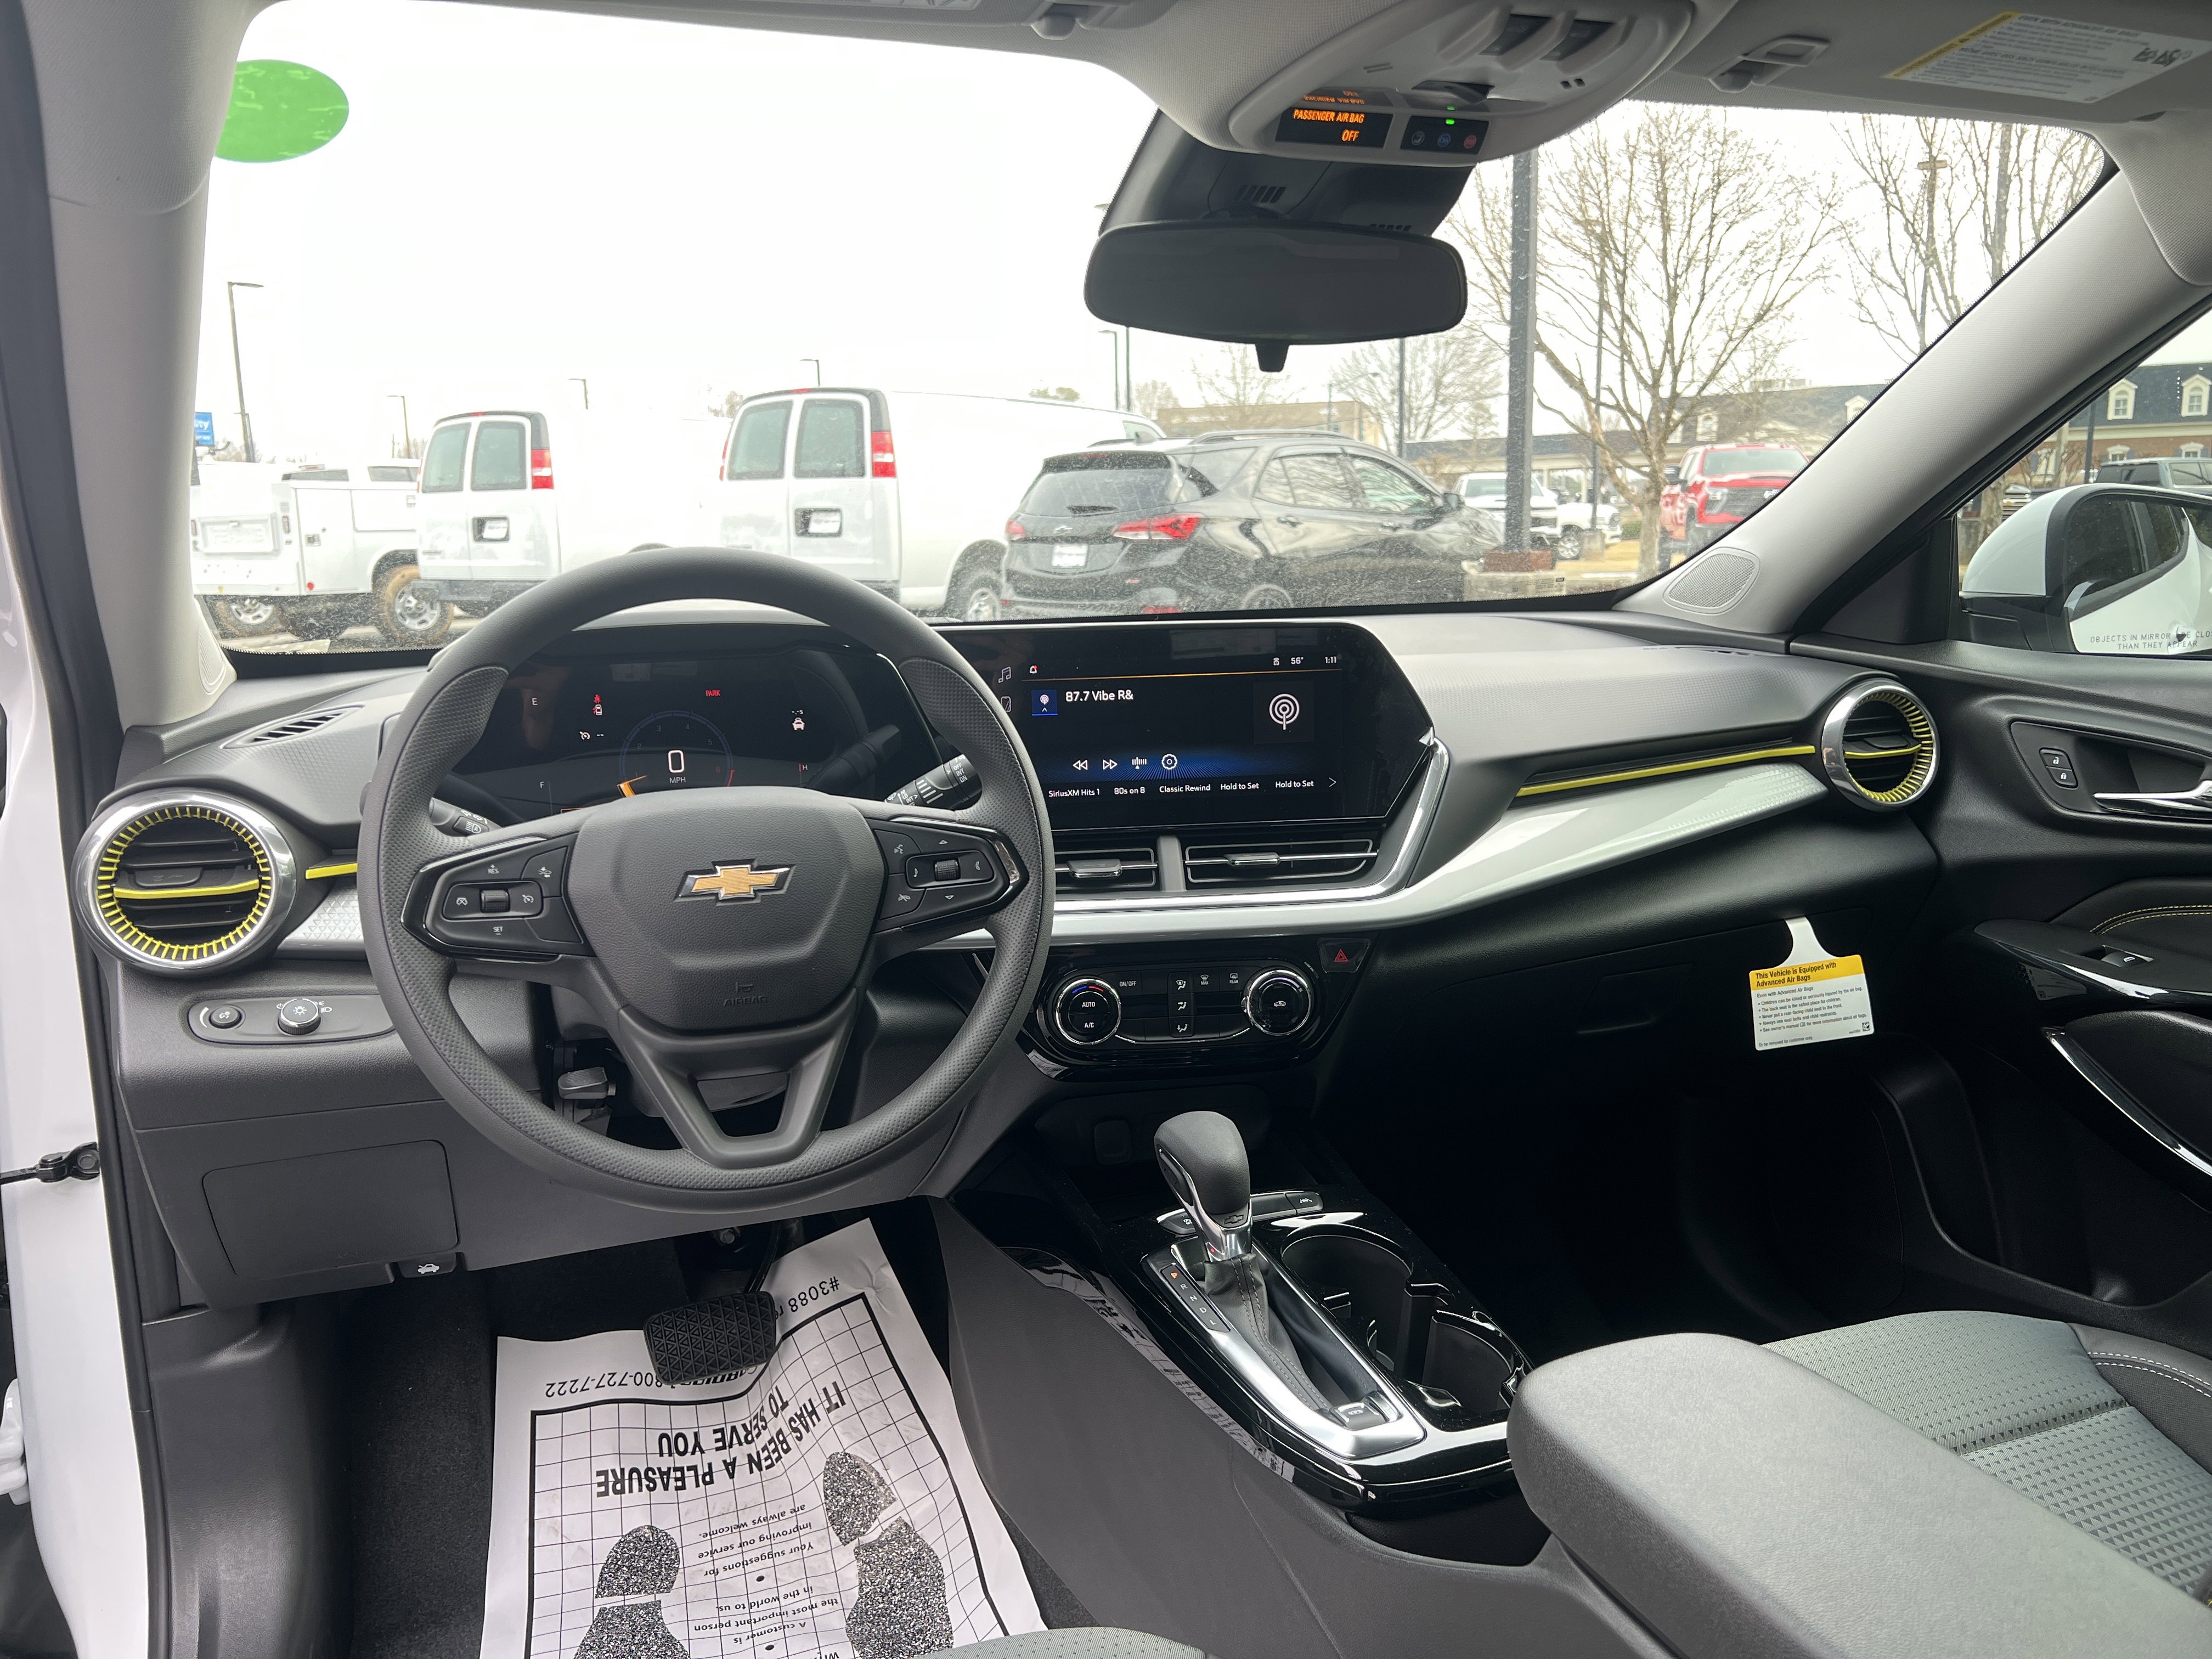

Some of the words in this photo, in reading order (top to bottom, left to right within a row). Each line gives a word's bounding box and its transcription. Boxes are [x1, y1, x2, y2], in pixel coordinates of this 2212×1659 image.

[1293, 109, 1335, 122] PASSENGER
[1336, 112, 1349, 123] AIR
[1349, 113, 1364, 123] BAG
[1342, 129, 1359, 142] OFF
[1065, 691, 1090, 702] 87.7
[1092, 690, 1115, 701] Vibe
[1118, 690, 1133, 700] R&
[668, 749, 685, 773] 0
[1048, 789, 1079, 797] SiriusXM
[1159, 785, 1183, 793] Classic
[1185, 784, 1211, 792] Rewind
[1769, 969, 1791, 977] Vehicle
[1798, 963, 1824, 974] Equipped
[1825, 961, 1837, 969] with
[1757, 978, 1785, 988] Advanced
[724, 996, 767, 1006] AIRBAG
[788, 1276, 839, 1313] #3088
[769, 1385, 789, 1419] TO
[822, 1380, 846, 1414] IT
[788, 1397, 821, 1442] HAS
[713, 1406, 768, 1452] SERVE
[658, 1431, 706, 1457] YOU
[747, 1427, 793, 1475] BEEN
[722, 1456, 737, 1480] A
[595, 1462, 714, 1498] PLEASURE
[790, 1504, 805, 1514] are
[752, 1511, 787, 1526] always
[699, 1522, 748, 1538] welcome.
[759, 1522, 812, 1543] improving
[737, 1538, 755, 1548] our
[789, 1542, 814, 1554] Your
[698, 1544, 734, 1559] service
[723, 1549, 786, 1572] suggestions
[703, 1567, 720, 1576] for
[783, 1589, 800, 1600] the
[803, 1585, 814, 1594] in
[749, 1596, 780, 1610] world
[792, 1602, 817, 1615] most
[821, 1598, 839, 1607] the
[694, 1620, 731, 1631] person
[735, 1610, 789, 1627] important
[745, 1623, 795, 1640] customer
